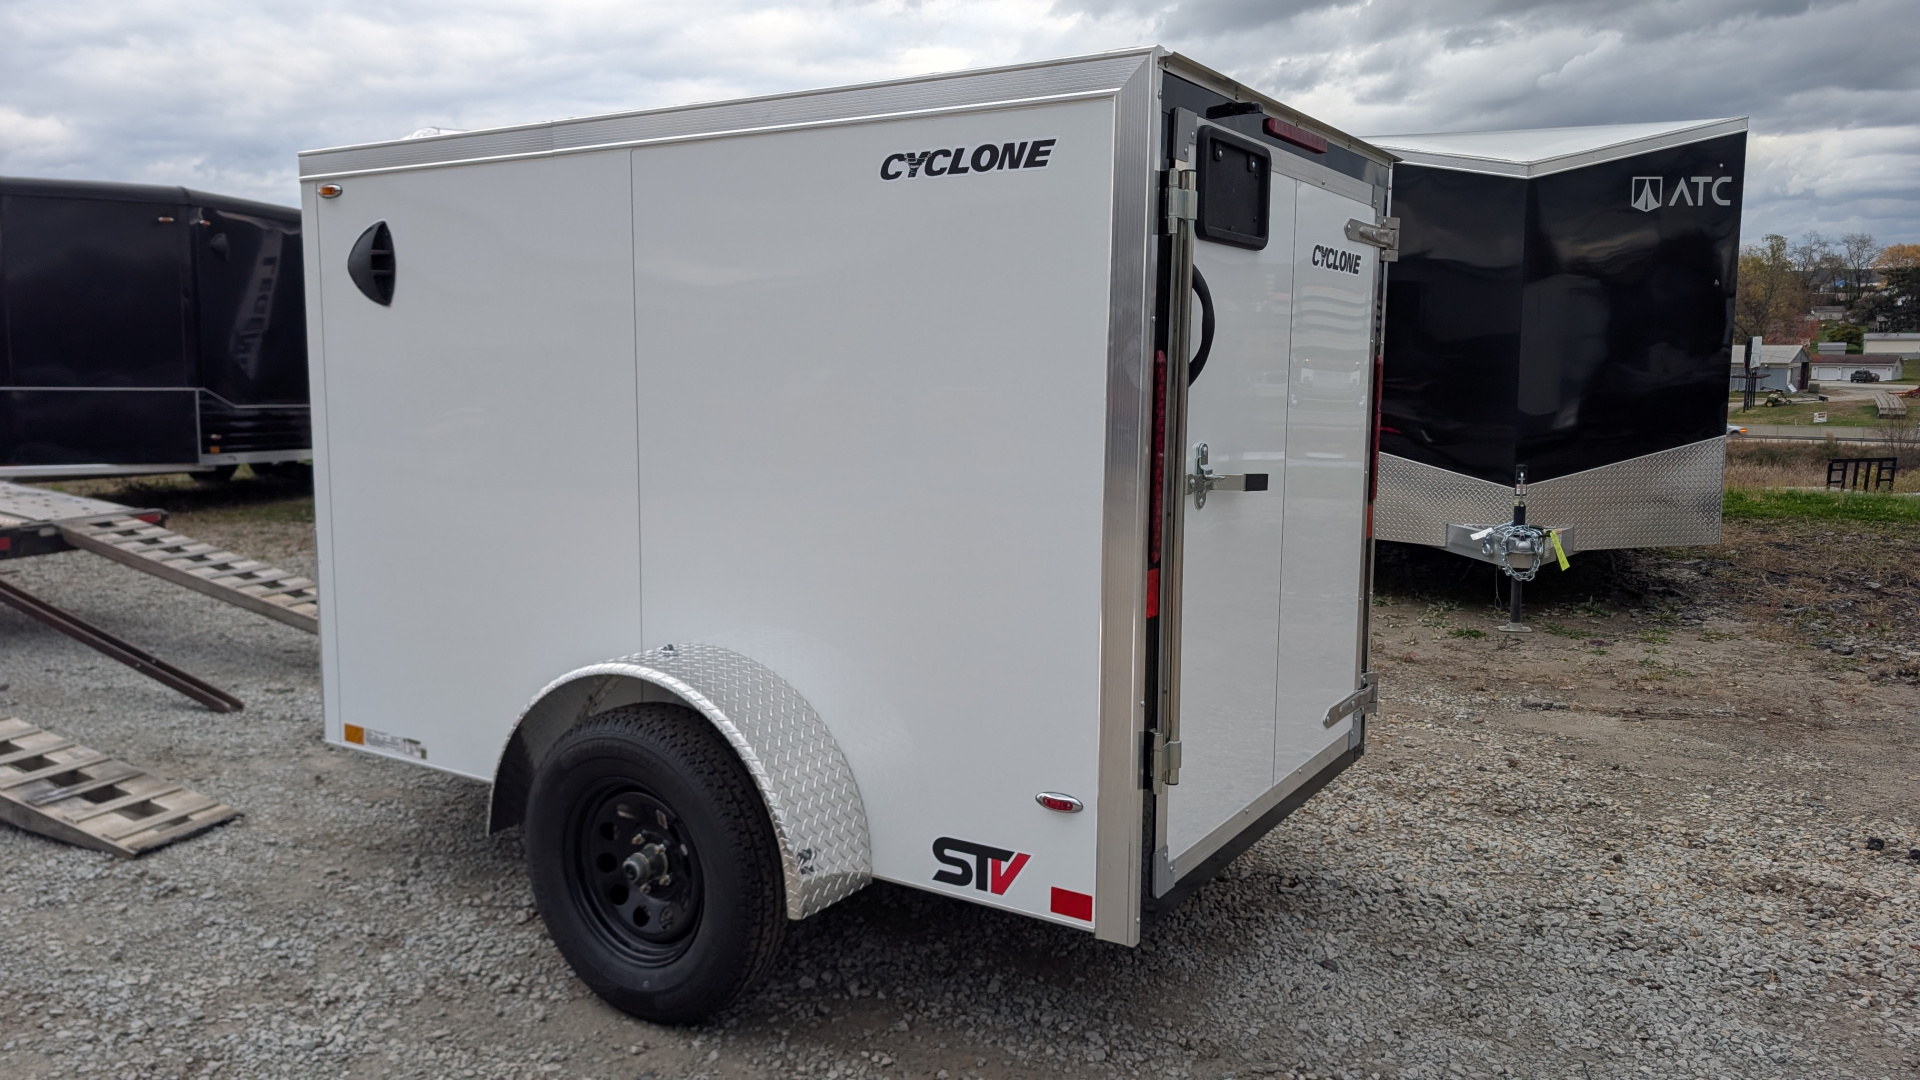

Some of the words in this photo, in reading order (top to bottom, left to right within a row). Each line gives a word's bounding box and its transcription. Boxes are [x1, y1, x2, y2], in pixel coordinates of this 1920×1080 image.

[880, 138, 1057, 180] CYCLONE
[1668, 176, 1733, 206] ATC
[1312, 244, 1362, 274] CYCLONE
[932, 836, 1031, 896] STV
